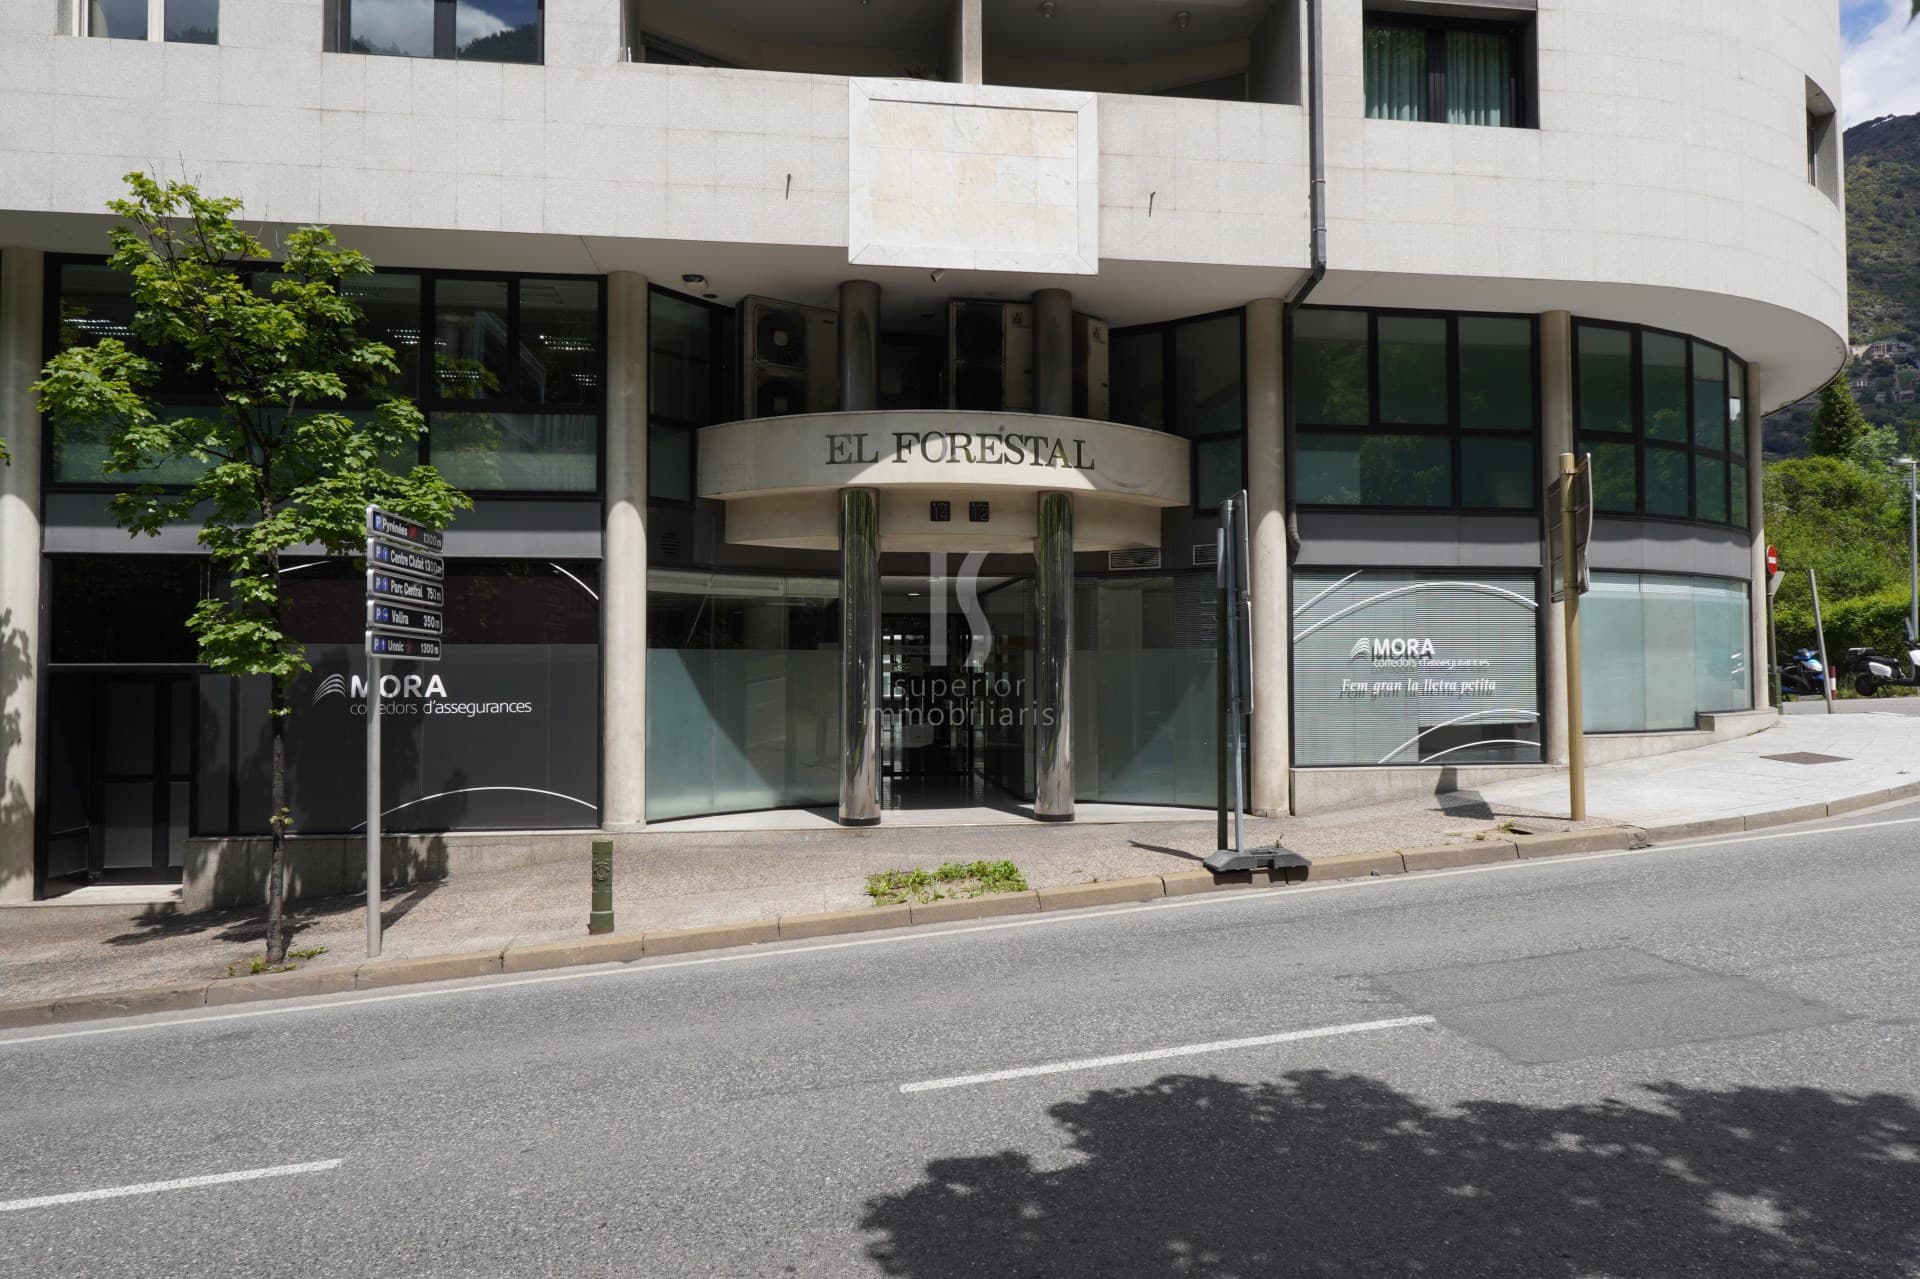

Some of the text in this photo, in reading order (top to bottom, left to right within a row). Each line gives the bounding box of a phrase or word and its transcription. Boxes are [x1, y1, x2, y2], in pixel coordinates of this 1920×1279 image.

[825, 431, 1095, 470] EL FORESTAL
[391, 549, 408, 566] Centre
[391, 580, 403, 594] Parc
[404, 582, 423, 597] Central
[392, 610, 409, 624] Valira
[1374, 638, 1436, 655] MORA
[1342, 679, 1368, 692] Fem
[1373, 682, 1402, 694] gran
[1407, 678, 1418, 691] la
[1424, 679, 1456, 692] lletra
[350, 701, 532, 717] coedors d'assegurances
